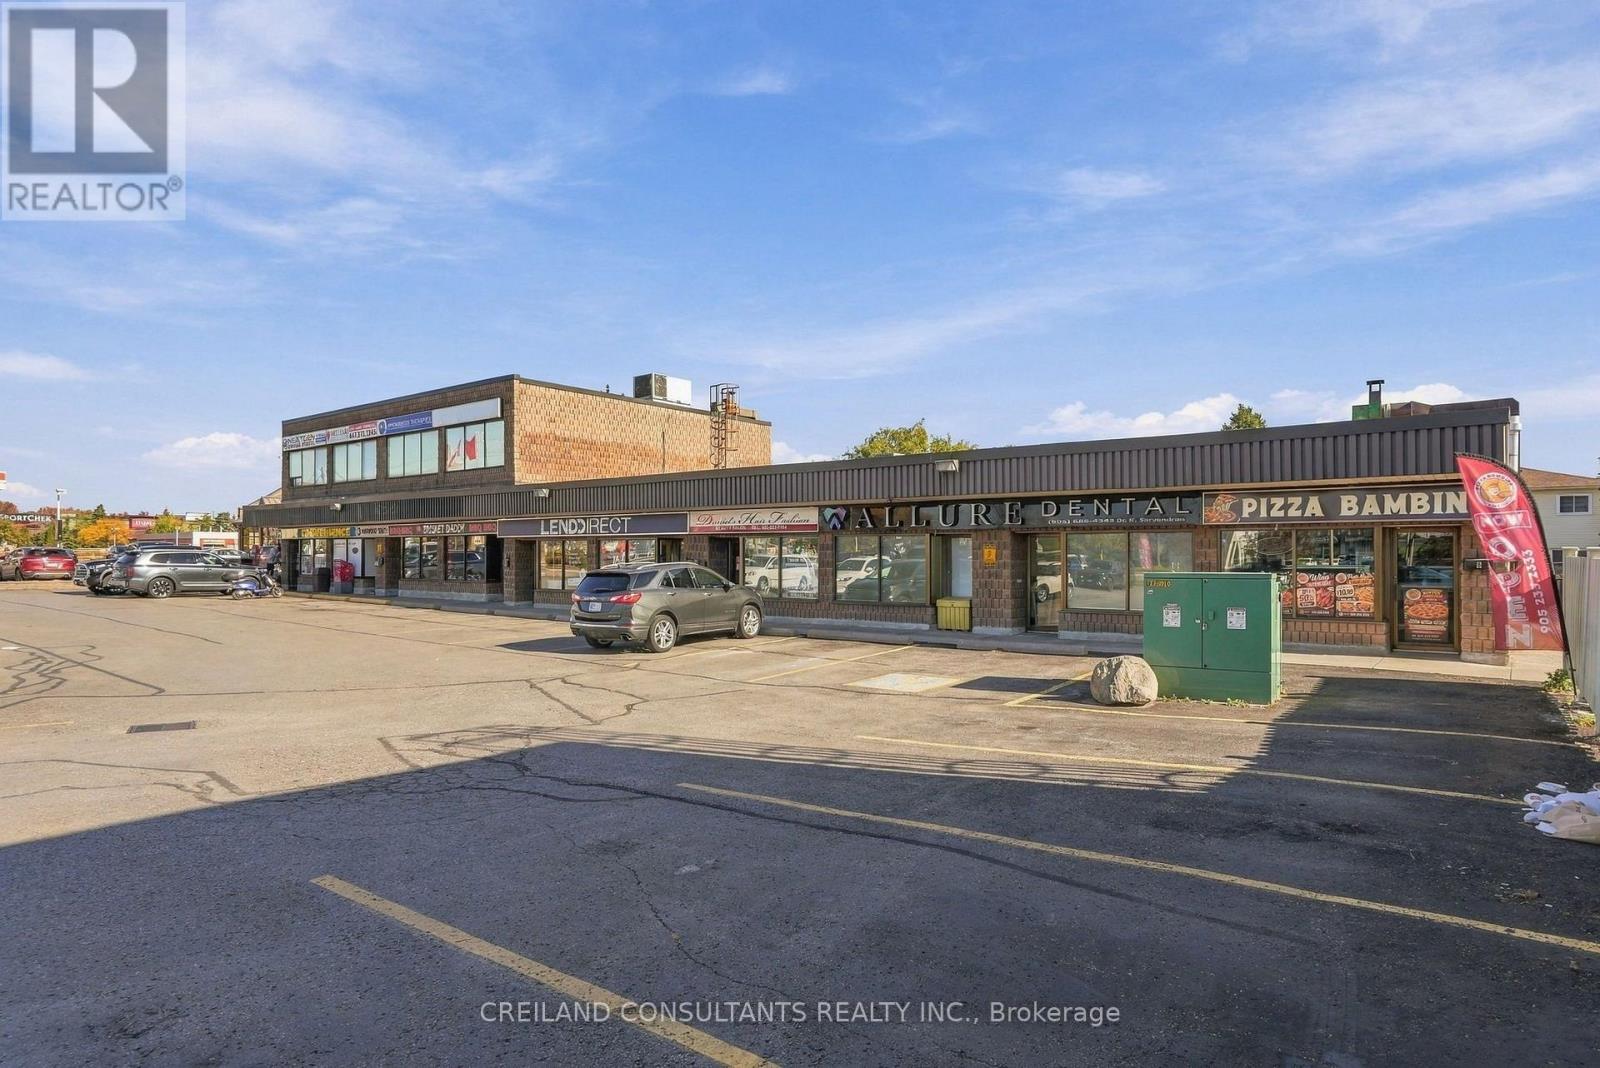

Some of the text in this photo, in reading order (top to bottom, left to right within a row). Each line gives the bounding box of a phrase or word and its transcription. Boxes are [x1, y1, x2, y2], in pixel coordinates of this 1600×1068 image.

[769, 511, 810, 524] Fashion
[856, 496, 1190, 529] ALLURE DENTAL
[1241, 491, 1469, 519] PIZZA BAMBIN
